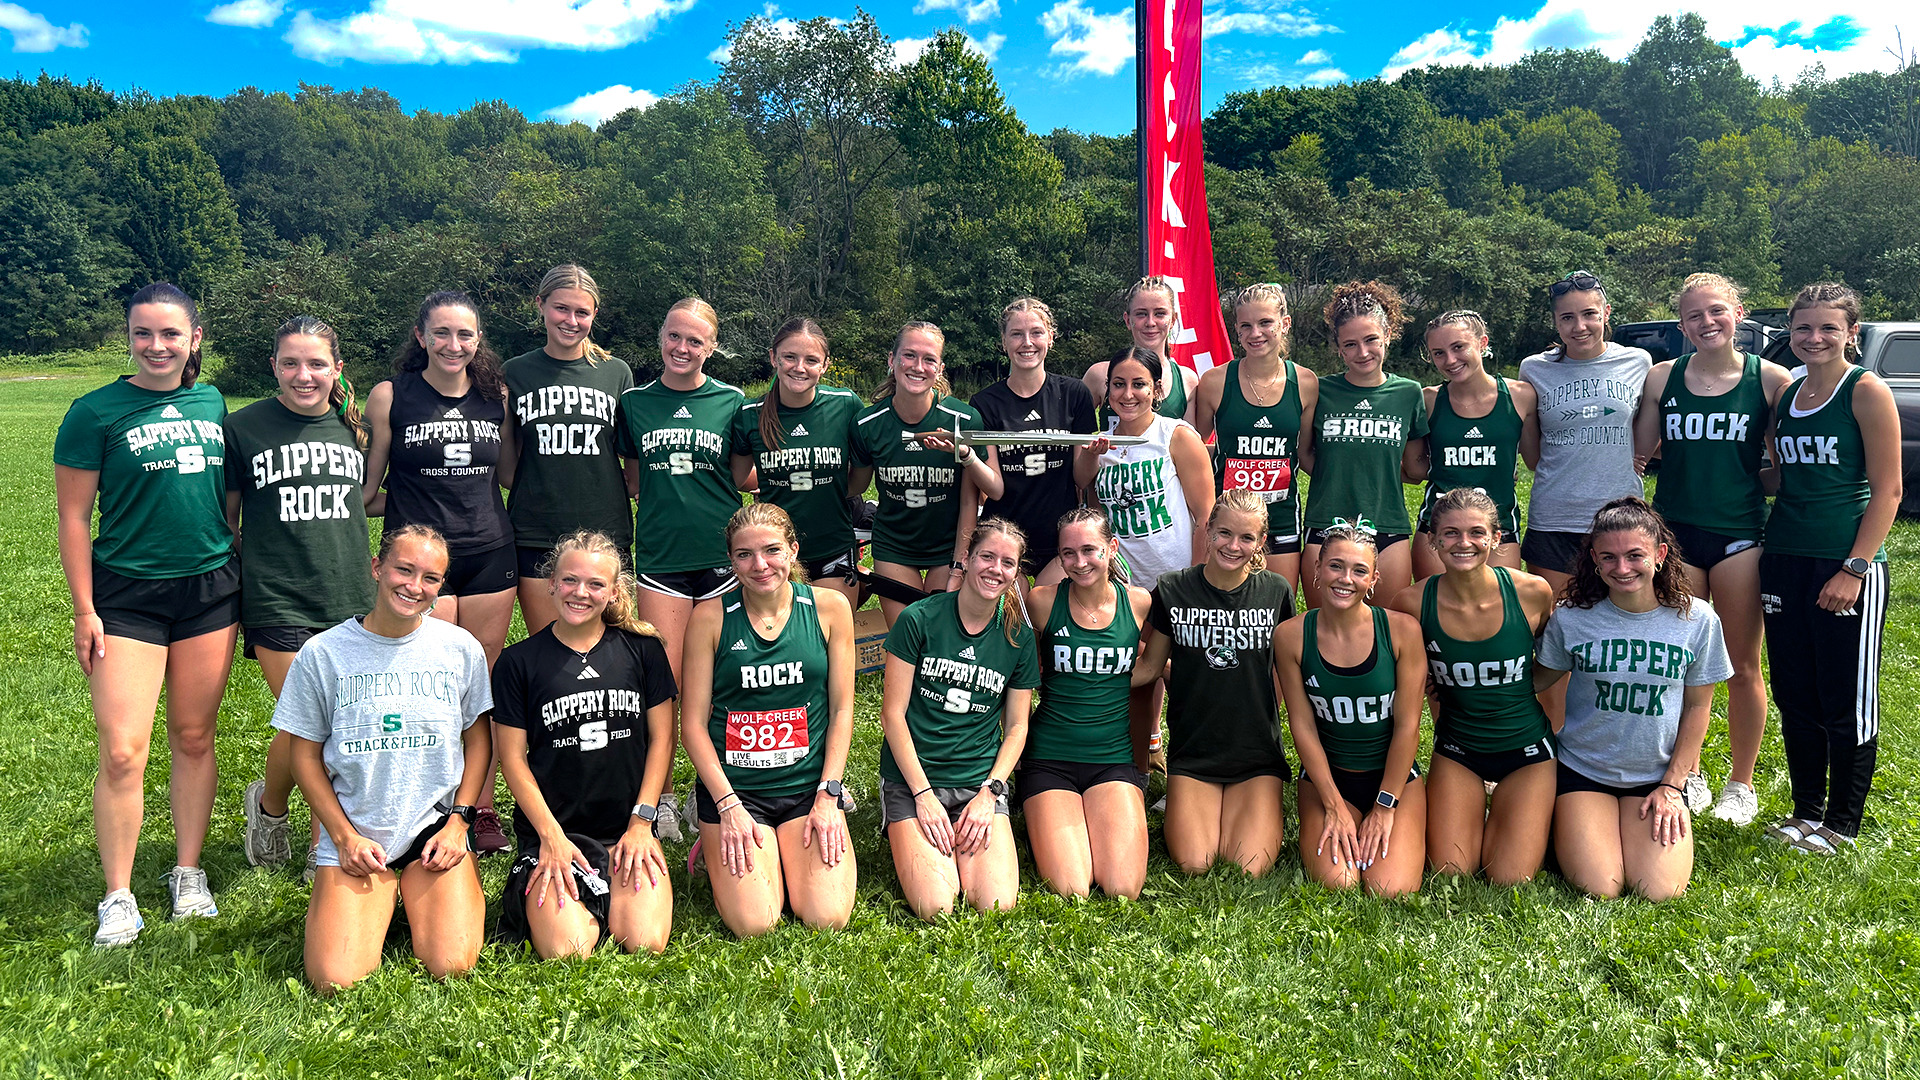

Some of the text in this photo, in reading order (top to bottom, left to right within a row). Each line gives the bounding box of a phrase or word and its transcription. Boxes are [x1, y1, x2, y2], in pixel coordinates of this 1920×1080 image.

[516, 385, 616, 427] SLIPPERY
[1605, 379, 1635, 409] ROCK
[1379, 414, 1403, 422] ROCK
[1582, 405, 1598, 418] CC
[126, 420, 196, 452] SLIPPERY
[404, 420, 502, 444] SLIPPERY ROCK
[536, 423, 601, 455] ROCK
[1666, 412, 1750, 442] ROCK
[135, 438, 223, 456] UNIVERSIT
[641, 428, 724, 455] SLIPPERY ROCK
[645, 445, 721, 459] UNIVERSITY
[1237, 436, 1288, 456] ROCK
[1372, 439, 1401, 447] FIELD
[142, 459, 177, 472] TRACK
[176, 445, 206, 474] S
[252, 441, 365, 490] SLIPPERY
[443, 442, 472, 467] S
[649, 452, 715, 475] TRACK S FIELD
[760, 447, 842, 469] SLIPPERY ROCK
[1002, 453, 1063, 476] TRACK S FIELD
[1228, 460, 1288, 470] WOLF CREEK
[1443, 445, 1497, 466] ROCK
[421, 466, 489, 476] CROSS COUNTRY
[763, 464, 841, 474] UNIVERSITY
[879, 466, 955, 484] SLIPPERY ROCK
[1097, 457, 1164, 498] LIPPERY
[1234, 469, 1281, 491] 987
[768, 471, 834, 492] TRACK S FIELD
[279, 484, 351, 522] ROCK
[886, 488, 947, 508] TRACK S FIELD
[1169, 606, 1275, 627] SLIPPERY ROCK
[1171, 623, 1274, 650] UNIVERSITY
[1053, 644, 1134, 675] ROCK
[1429, 655, 1527, 688] ROCK
[740, 661, 804, 689] ROCK
[921, 657, 1006, 694] SLIPPERY ROCK
[921, 675, 1000, 699] UNIVERSITY
[334, 670, 453, 712] SLIPPERY ROCK
[920, 687, 991, 714] TRACK S FIELD
[1594, 679, 1668, 716] ROCK
[541, 689, 641, 727] SLIPPERY ROCK
[731, 709, 805, 724] WOLF CREEK
[1308, 690, 1396, 724] ROCK
[382, 714, 402, 732] S
[548, 711, 640, 732] UNIVERSITY
[578, 720, 609, 752] S
[610, 728, 631, 740] FIELD
[739, 722, 795, 750] 982
[732, 752, 751, 760] LIVE
[1523, 743, 1540, 757] S
